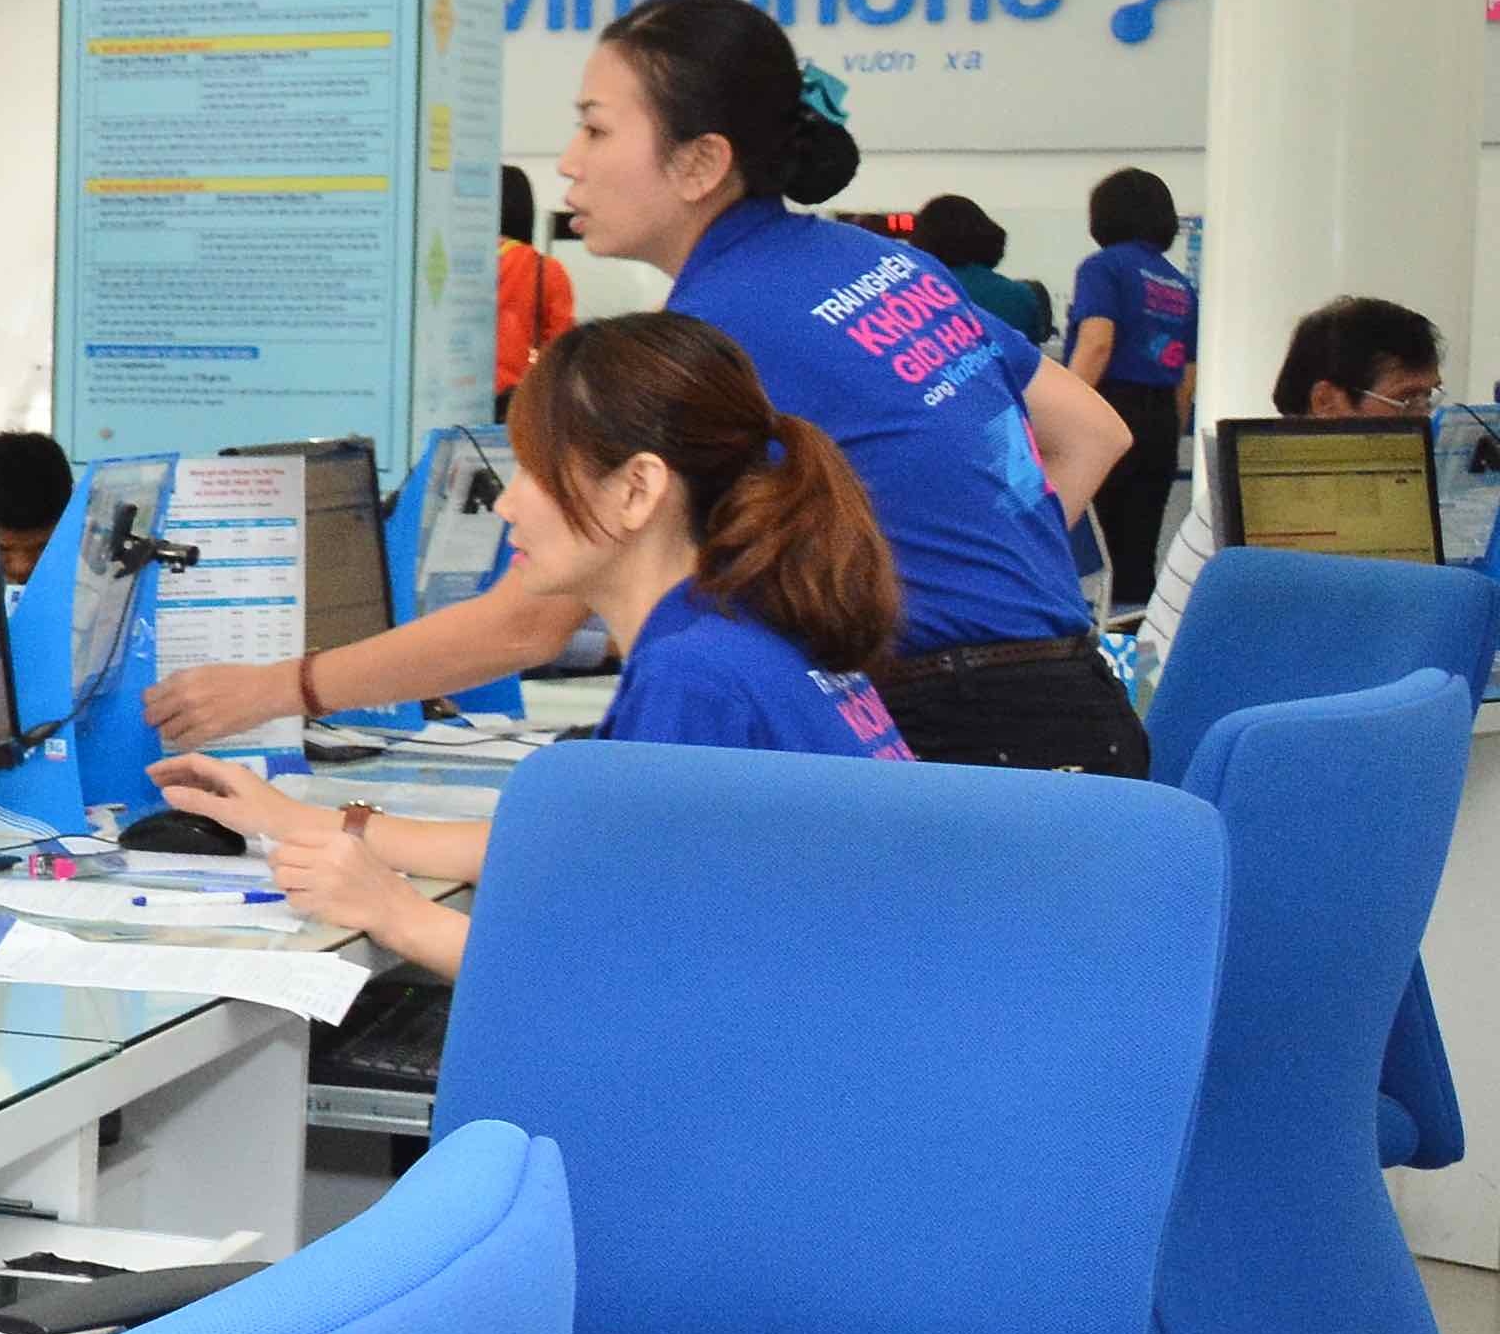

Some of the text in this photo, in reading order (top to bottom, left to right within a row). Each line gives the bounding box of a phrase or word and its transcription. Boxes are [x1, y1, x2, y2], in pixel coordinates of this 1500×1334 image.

[947, 50, 982, 70] xa
[846, 273, 959, 356] KHÔNG
[924, 381, 956, 406] cùng
